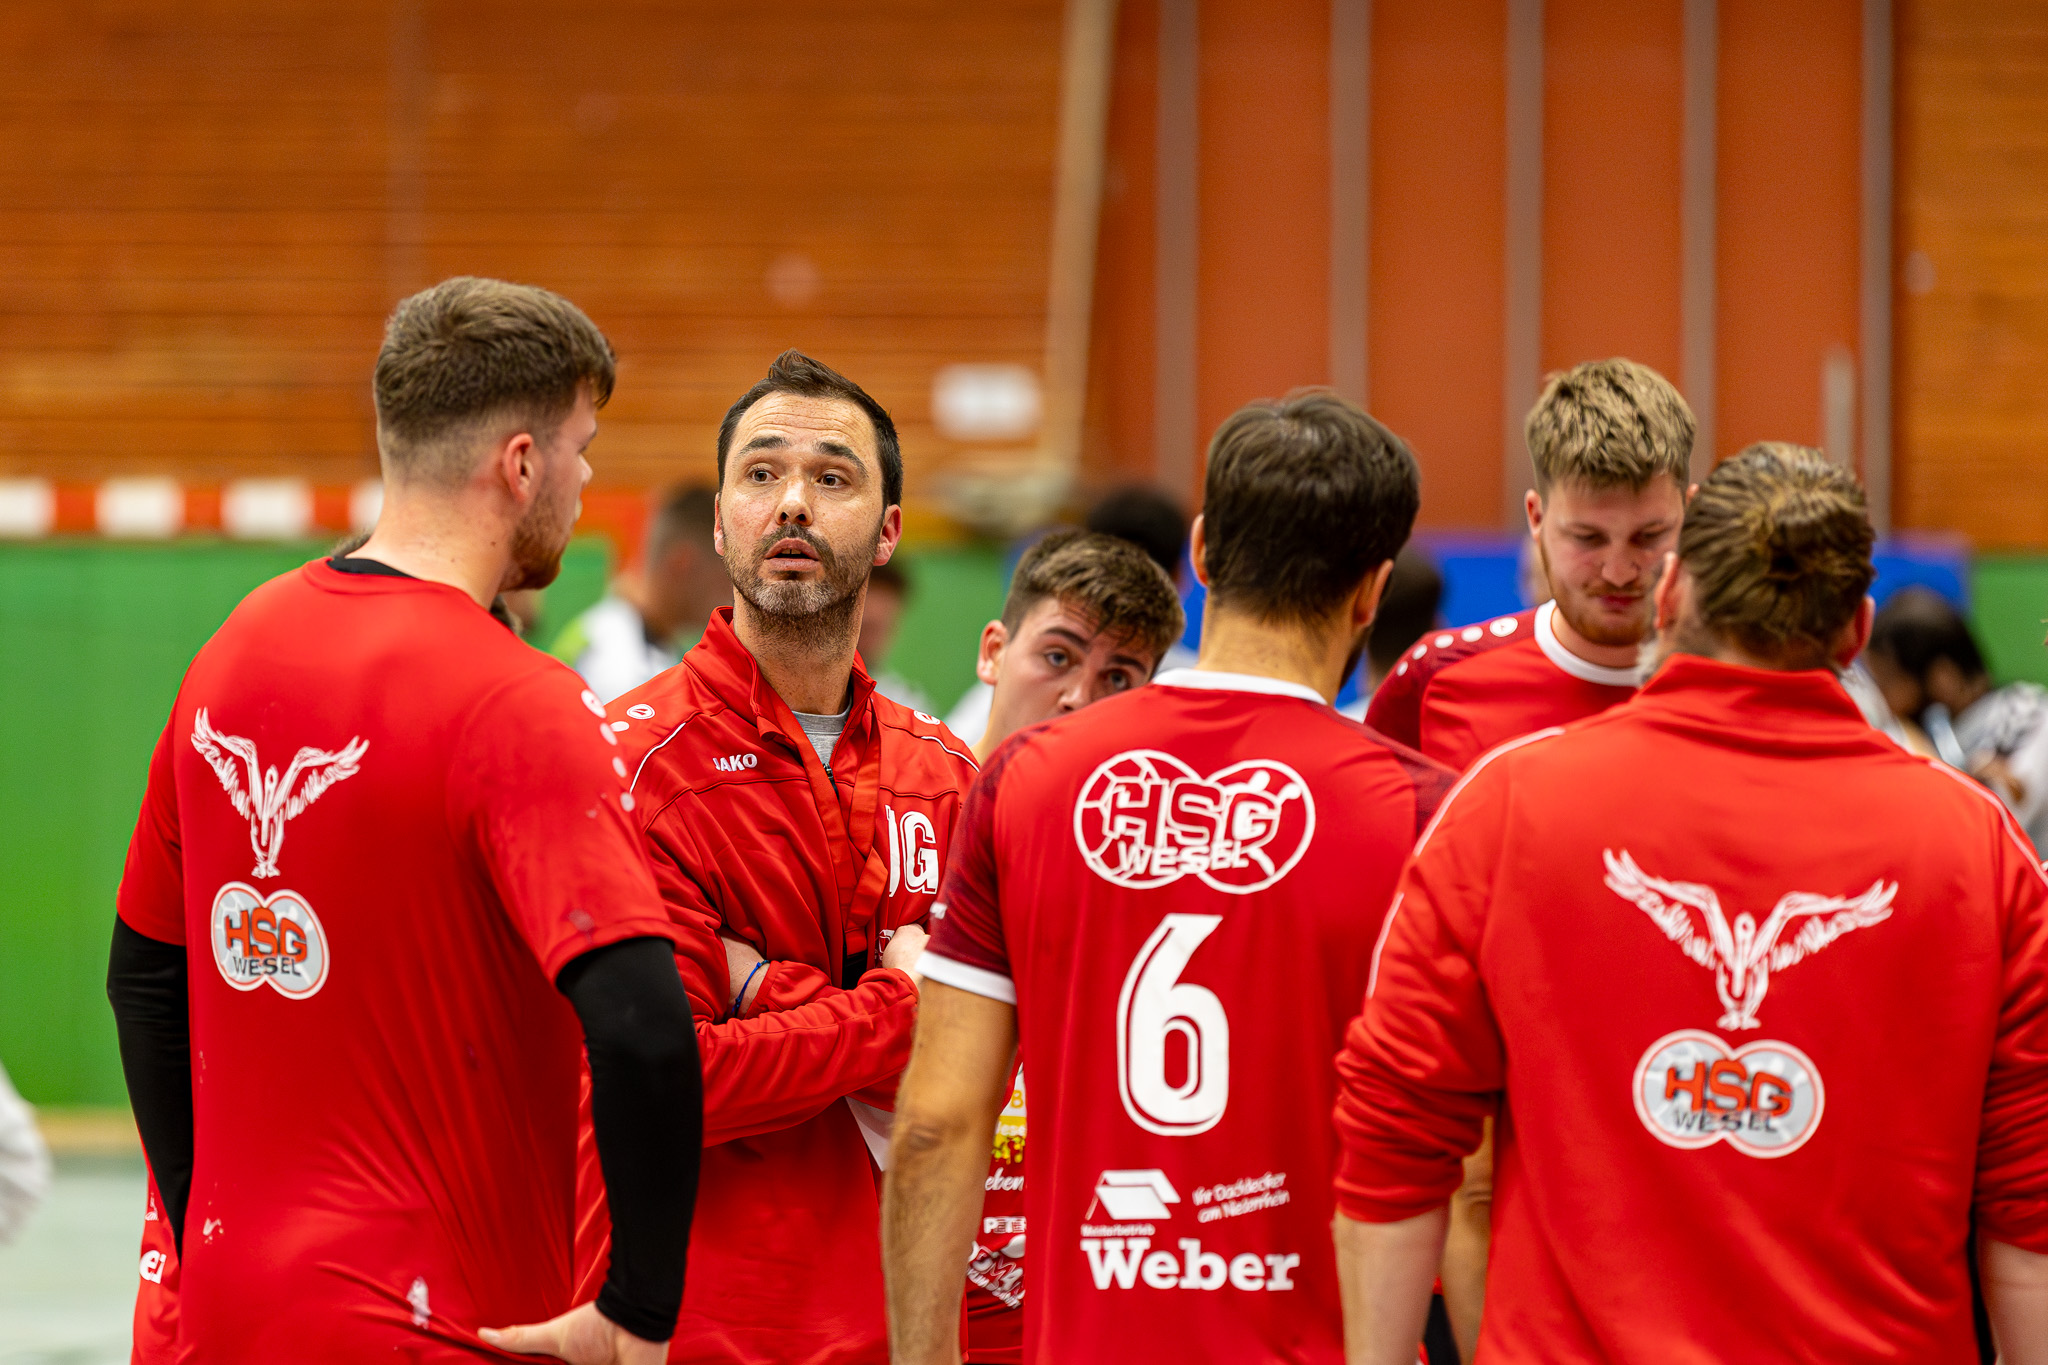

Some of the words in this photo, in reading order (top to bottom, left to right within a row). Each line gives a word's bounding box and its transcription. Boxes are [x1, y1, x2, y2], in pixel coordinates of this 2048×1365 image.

[712, 753, 758, 772] JAKO
[1103, 777, 1283, 848] HSG
[1117, 840, 1249, 876] WESEL
[224, 907, 308, 964] HSG
[232, 956, 302, 977] WESEL
[1116, 912, 1229, 1137] 6
[1664, 1059, 1793, 1118] HSG
[1672, 1109, 1779, 1134] WESEL
[1212, 1171, 1287, 1202] Dachdecker
[1080, 1237, 1300, 1291] Weber
